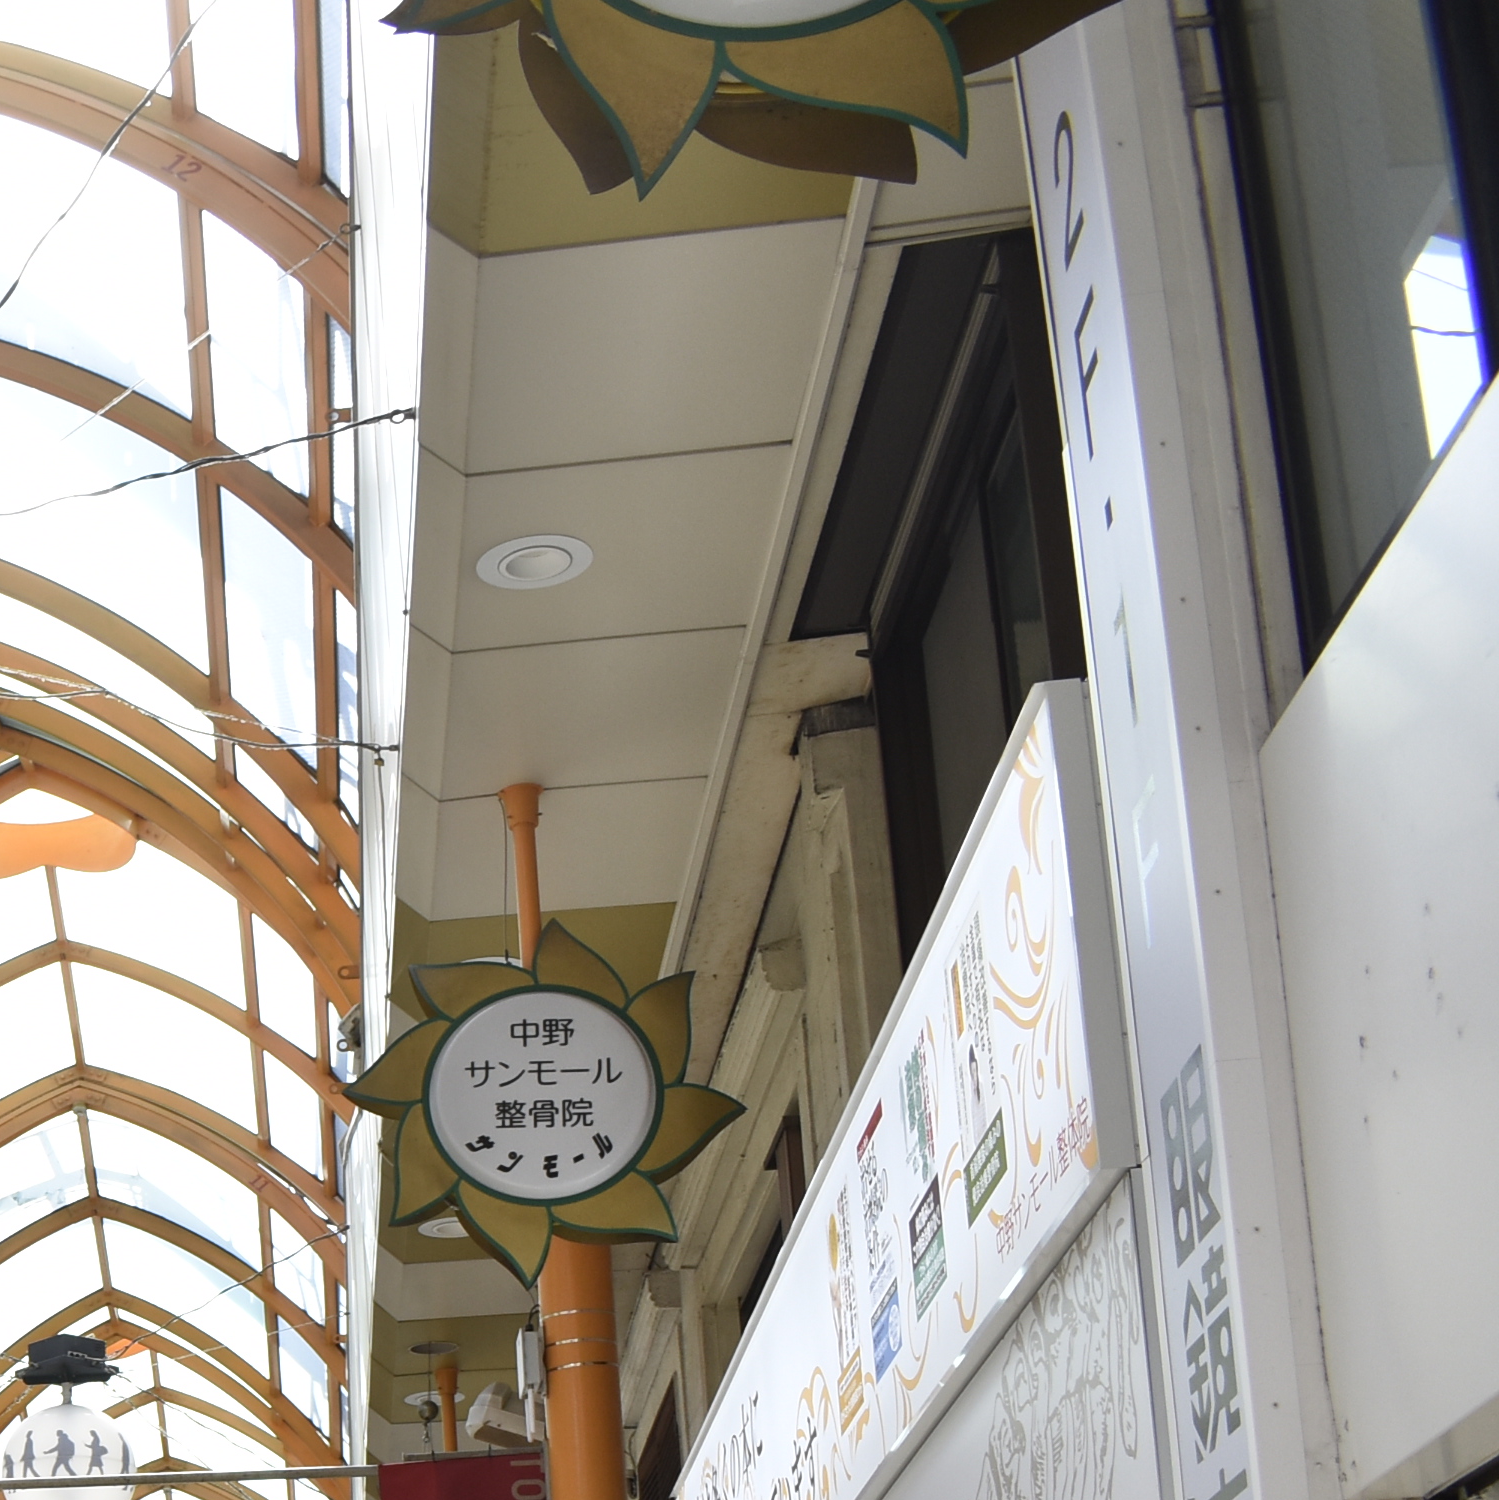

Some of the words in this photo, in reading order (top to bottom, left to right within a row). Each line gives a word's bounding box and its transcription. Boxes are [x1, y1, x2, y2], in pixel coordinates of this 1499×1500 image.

[510, 1018, 575, 1048] 中野
[465, 1057, 623, 1088] サンモール
[495, 1098, 594, 1129] 整骨院
[465, 1133, 614, 1178] サンモール
